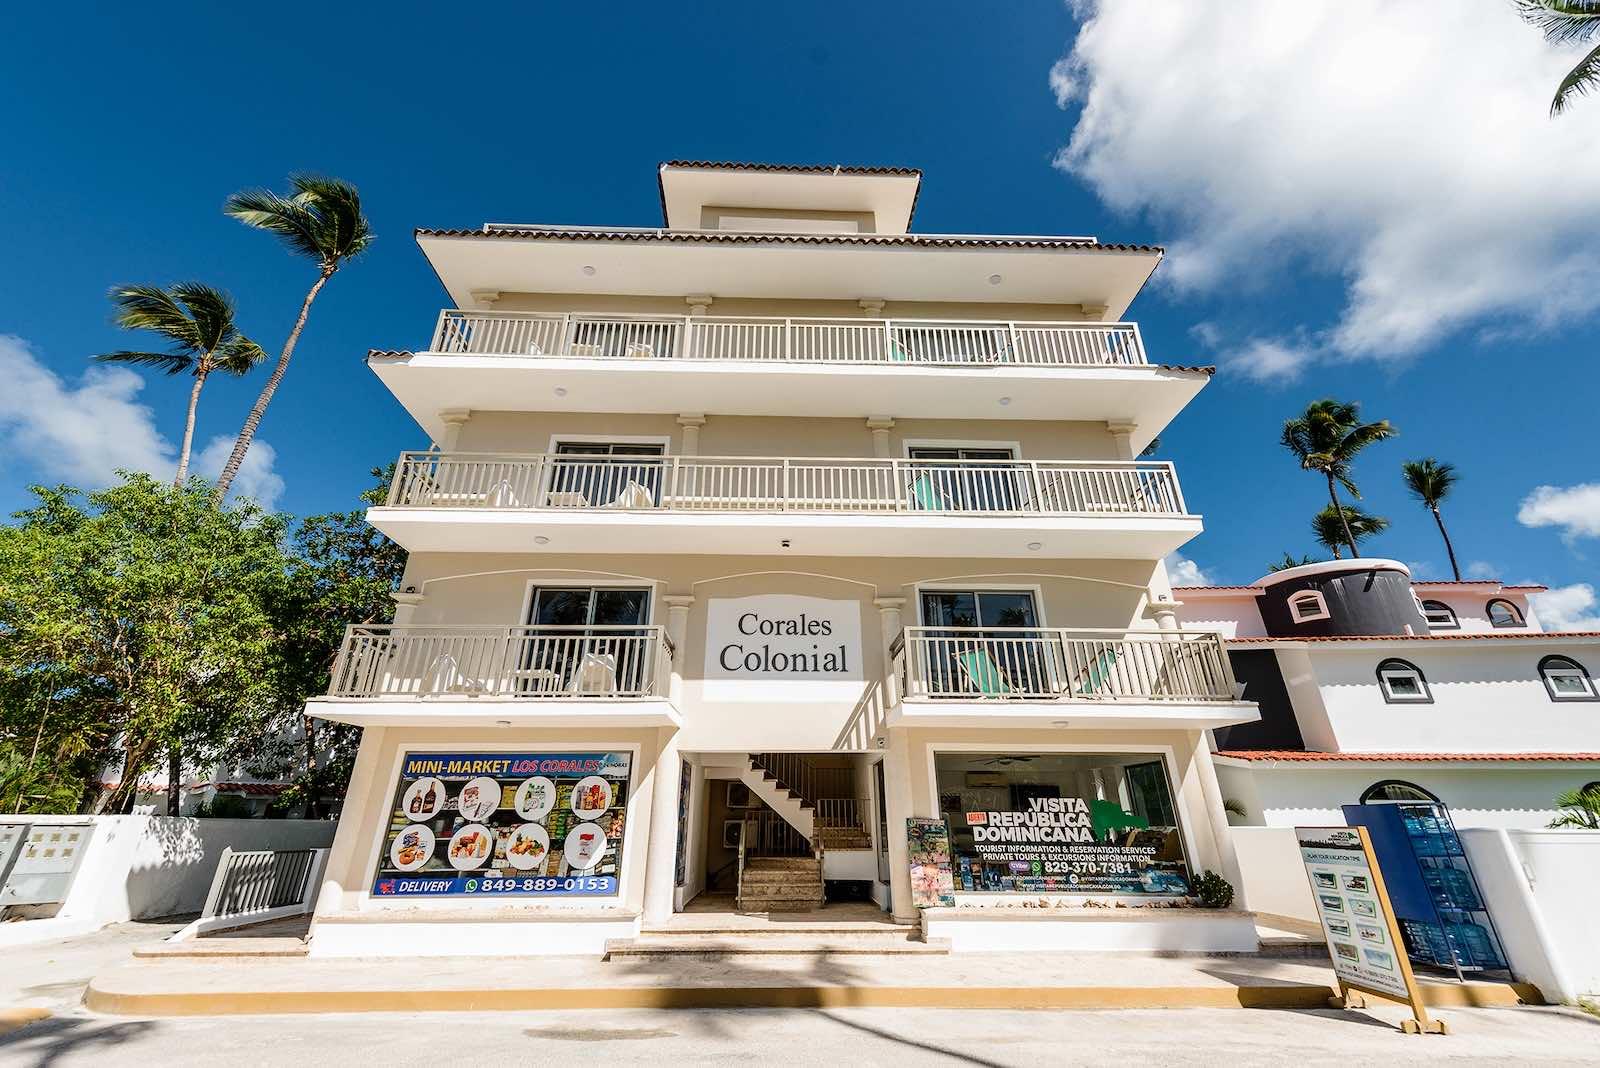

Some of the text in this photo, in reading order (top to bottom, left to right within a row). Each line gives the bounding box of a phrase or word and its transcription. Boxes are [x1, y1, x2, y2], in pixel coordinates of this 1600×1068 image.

[738, 613, 832, 635] Corales
[720, 644, 848, 672] Colonial
[407, 760, 511, 773] MINI-MARKET
[512, 760, 538, 773] LOS
[540, 760, 599, 772] CORALES
[1028, 797, 1089, 812] VISITA
[988, 808, 1092, 828] REPÚBLICA
[973, 826, 1095, 843] DOMINICANA
[974, 845, 1006, 853] TOURIST
[1070, 846, 1120, 854] RESERVATION
[983, 853, 1013, 861] PRIVATE
[1014, 853, 1040, 861] TOURS
[1048, 854, 1096, 862] EXCURSIONS
[1044, 861, 1132, 874] 829-370-7381
[399, 879, 609, 892] DELIVERY 849-889-0153
